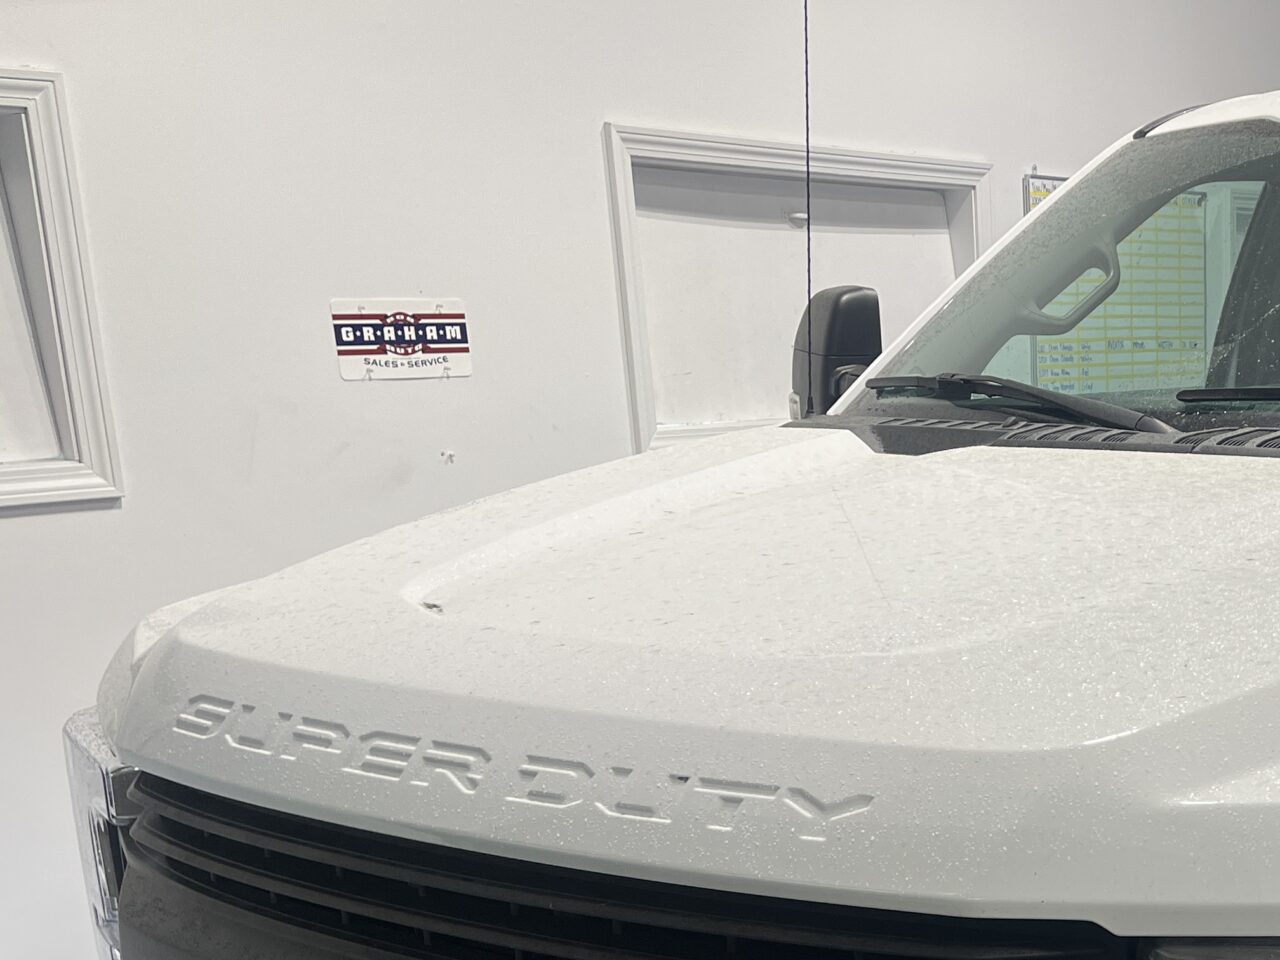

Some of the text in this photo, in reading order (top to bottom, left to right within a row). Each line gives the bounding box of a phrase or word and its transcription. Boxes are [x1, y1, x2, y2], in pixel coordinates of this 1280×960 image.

[340, 325, 462, 342] GRAHAM
[385, 343, 423, 354] AUTO
[363, 357, 399, 368] SALES
[407, 355, 449, 368] SERVICE
[172, 694, 875, 842] SUPER DUTY
